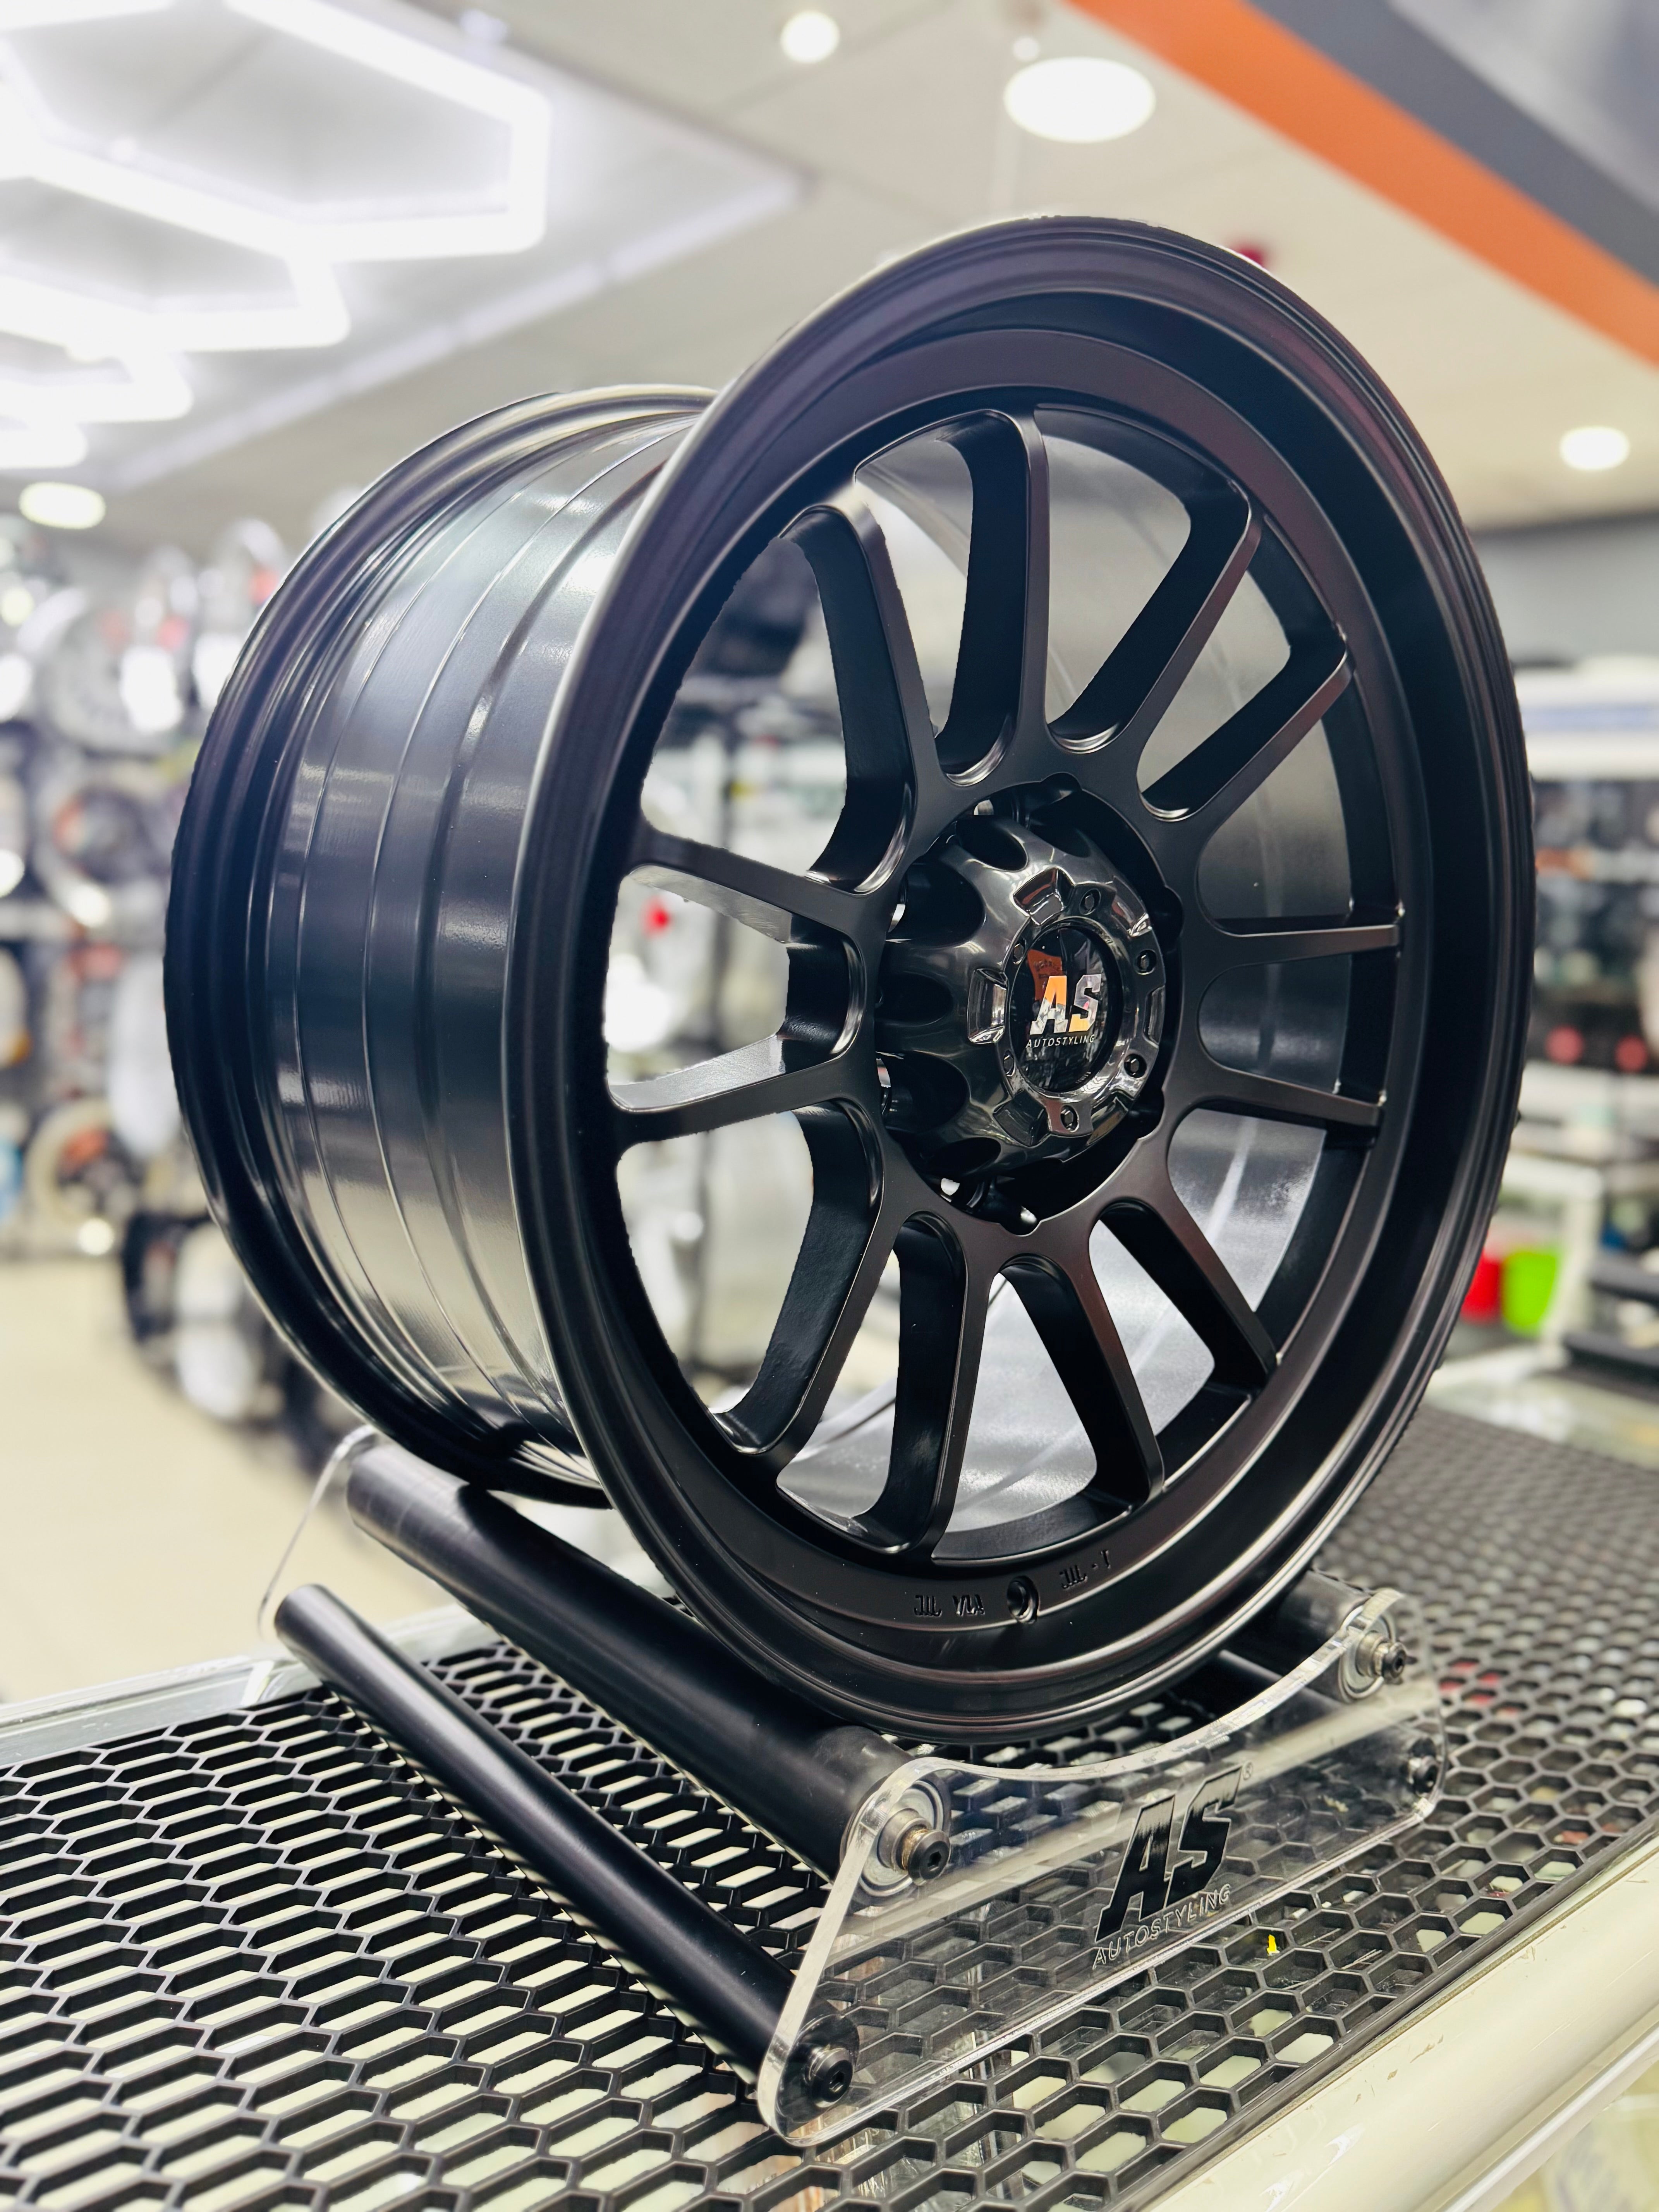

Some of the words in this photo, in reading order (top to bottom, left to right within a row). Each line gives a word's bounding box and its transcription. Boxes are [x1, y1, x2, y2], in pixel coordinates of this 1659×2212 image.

[1025, 1034, 1095, 1048] AUTOSTYLING
[1029, 974, 1102, 1035] AS
[1094, 1765, 1242, 1943] AS
[1092, 1883, 1232, 1971] AUTOSTYLING
